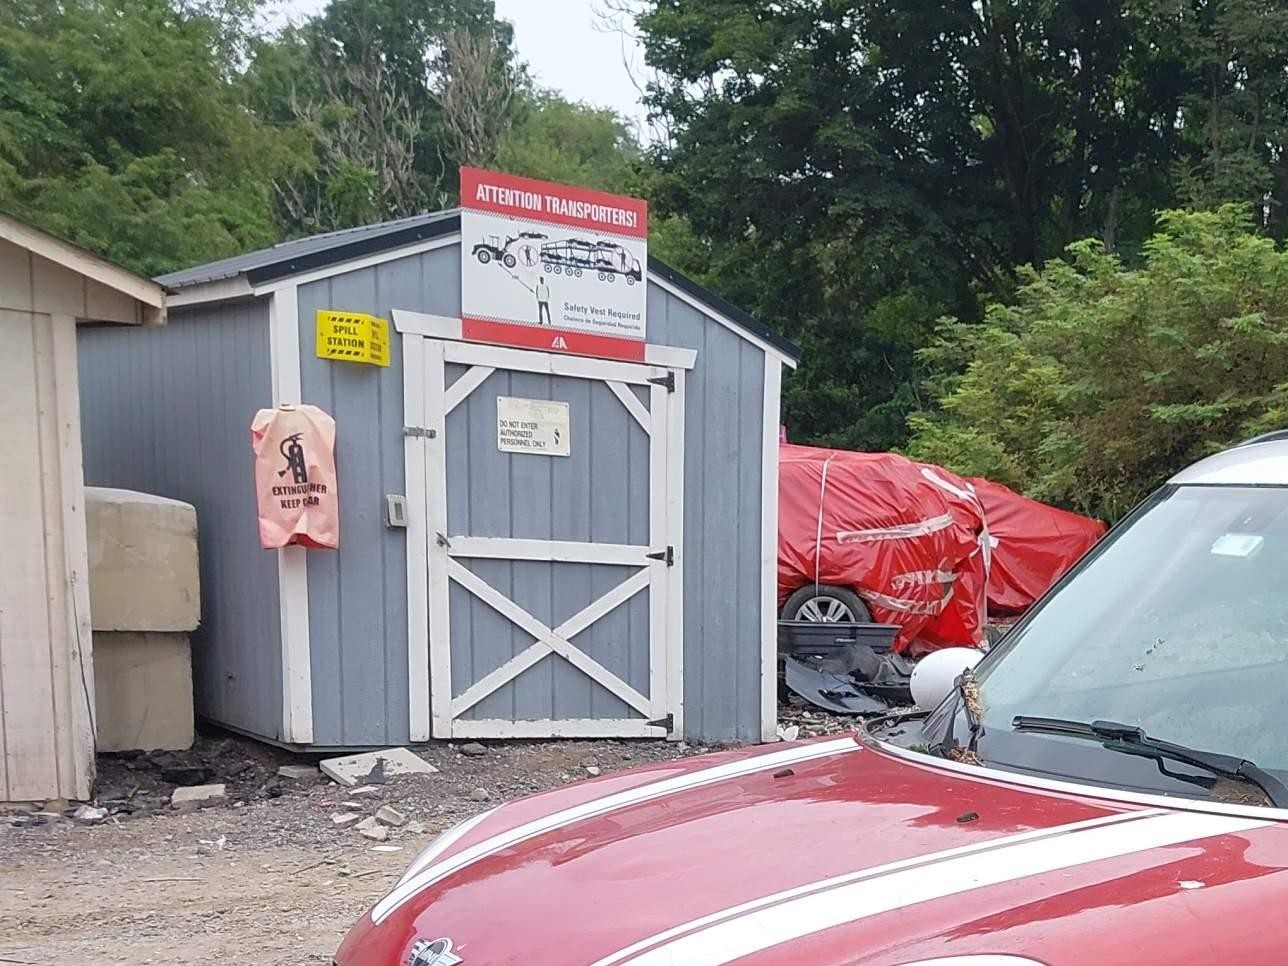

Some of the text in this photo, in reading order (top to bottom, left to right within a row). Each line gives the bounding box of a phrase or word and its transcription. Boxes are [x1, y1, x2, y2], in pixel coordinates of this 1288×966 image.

[476, 183, 637, 228] ATTENTION TRANSPORTERS!
[563, 302, 641, 321] Safety Vest Required
[333, 325, 358, 336] SPILL
[327, 336, 365, 348] STATION
[500, 420, 538, 430] DO NOT ENTER
[500, 429, 533, 438] AUTHORIZED
[500, 438, 546, 448] PERSONNEL ONLY
[280, 498, 301, 509] KEEP
